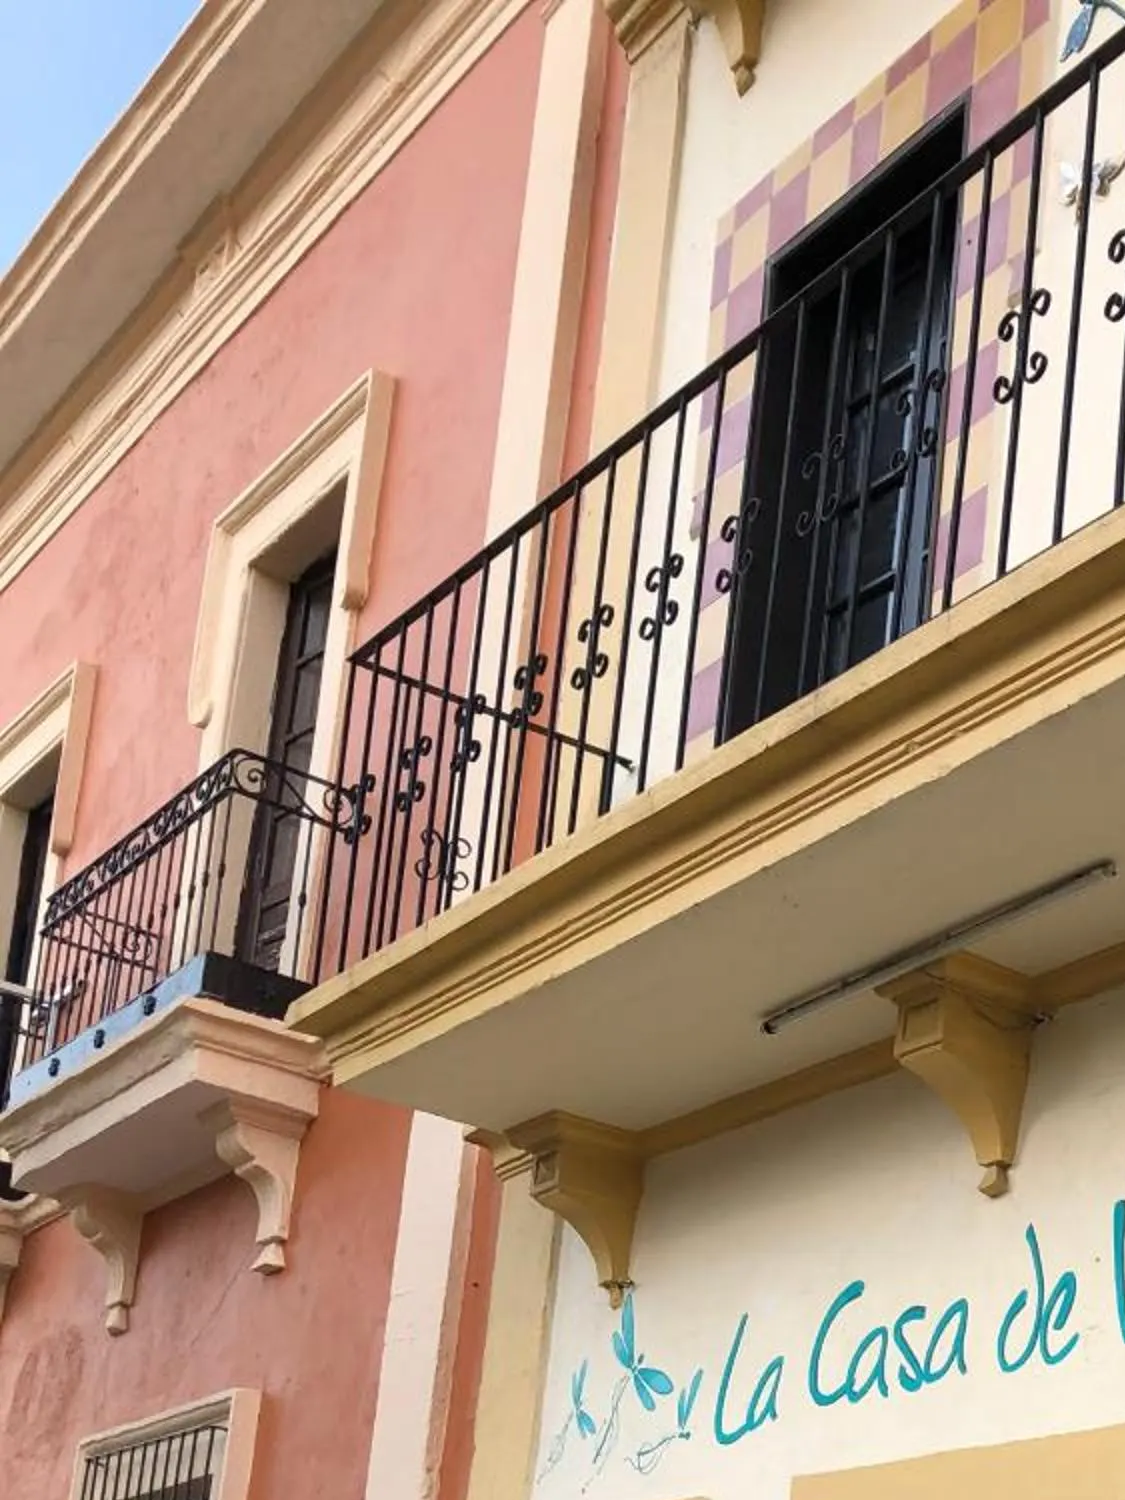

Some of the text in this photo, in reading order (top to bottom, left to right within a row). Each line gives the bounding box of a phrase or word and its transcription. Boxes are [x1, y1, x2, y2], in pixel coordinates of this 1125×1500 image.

[714, 1312, 784, 1446] La
[808, 1279, 969, 1407] Casa
[996, 1221, 1080, 1374] de
